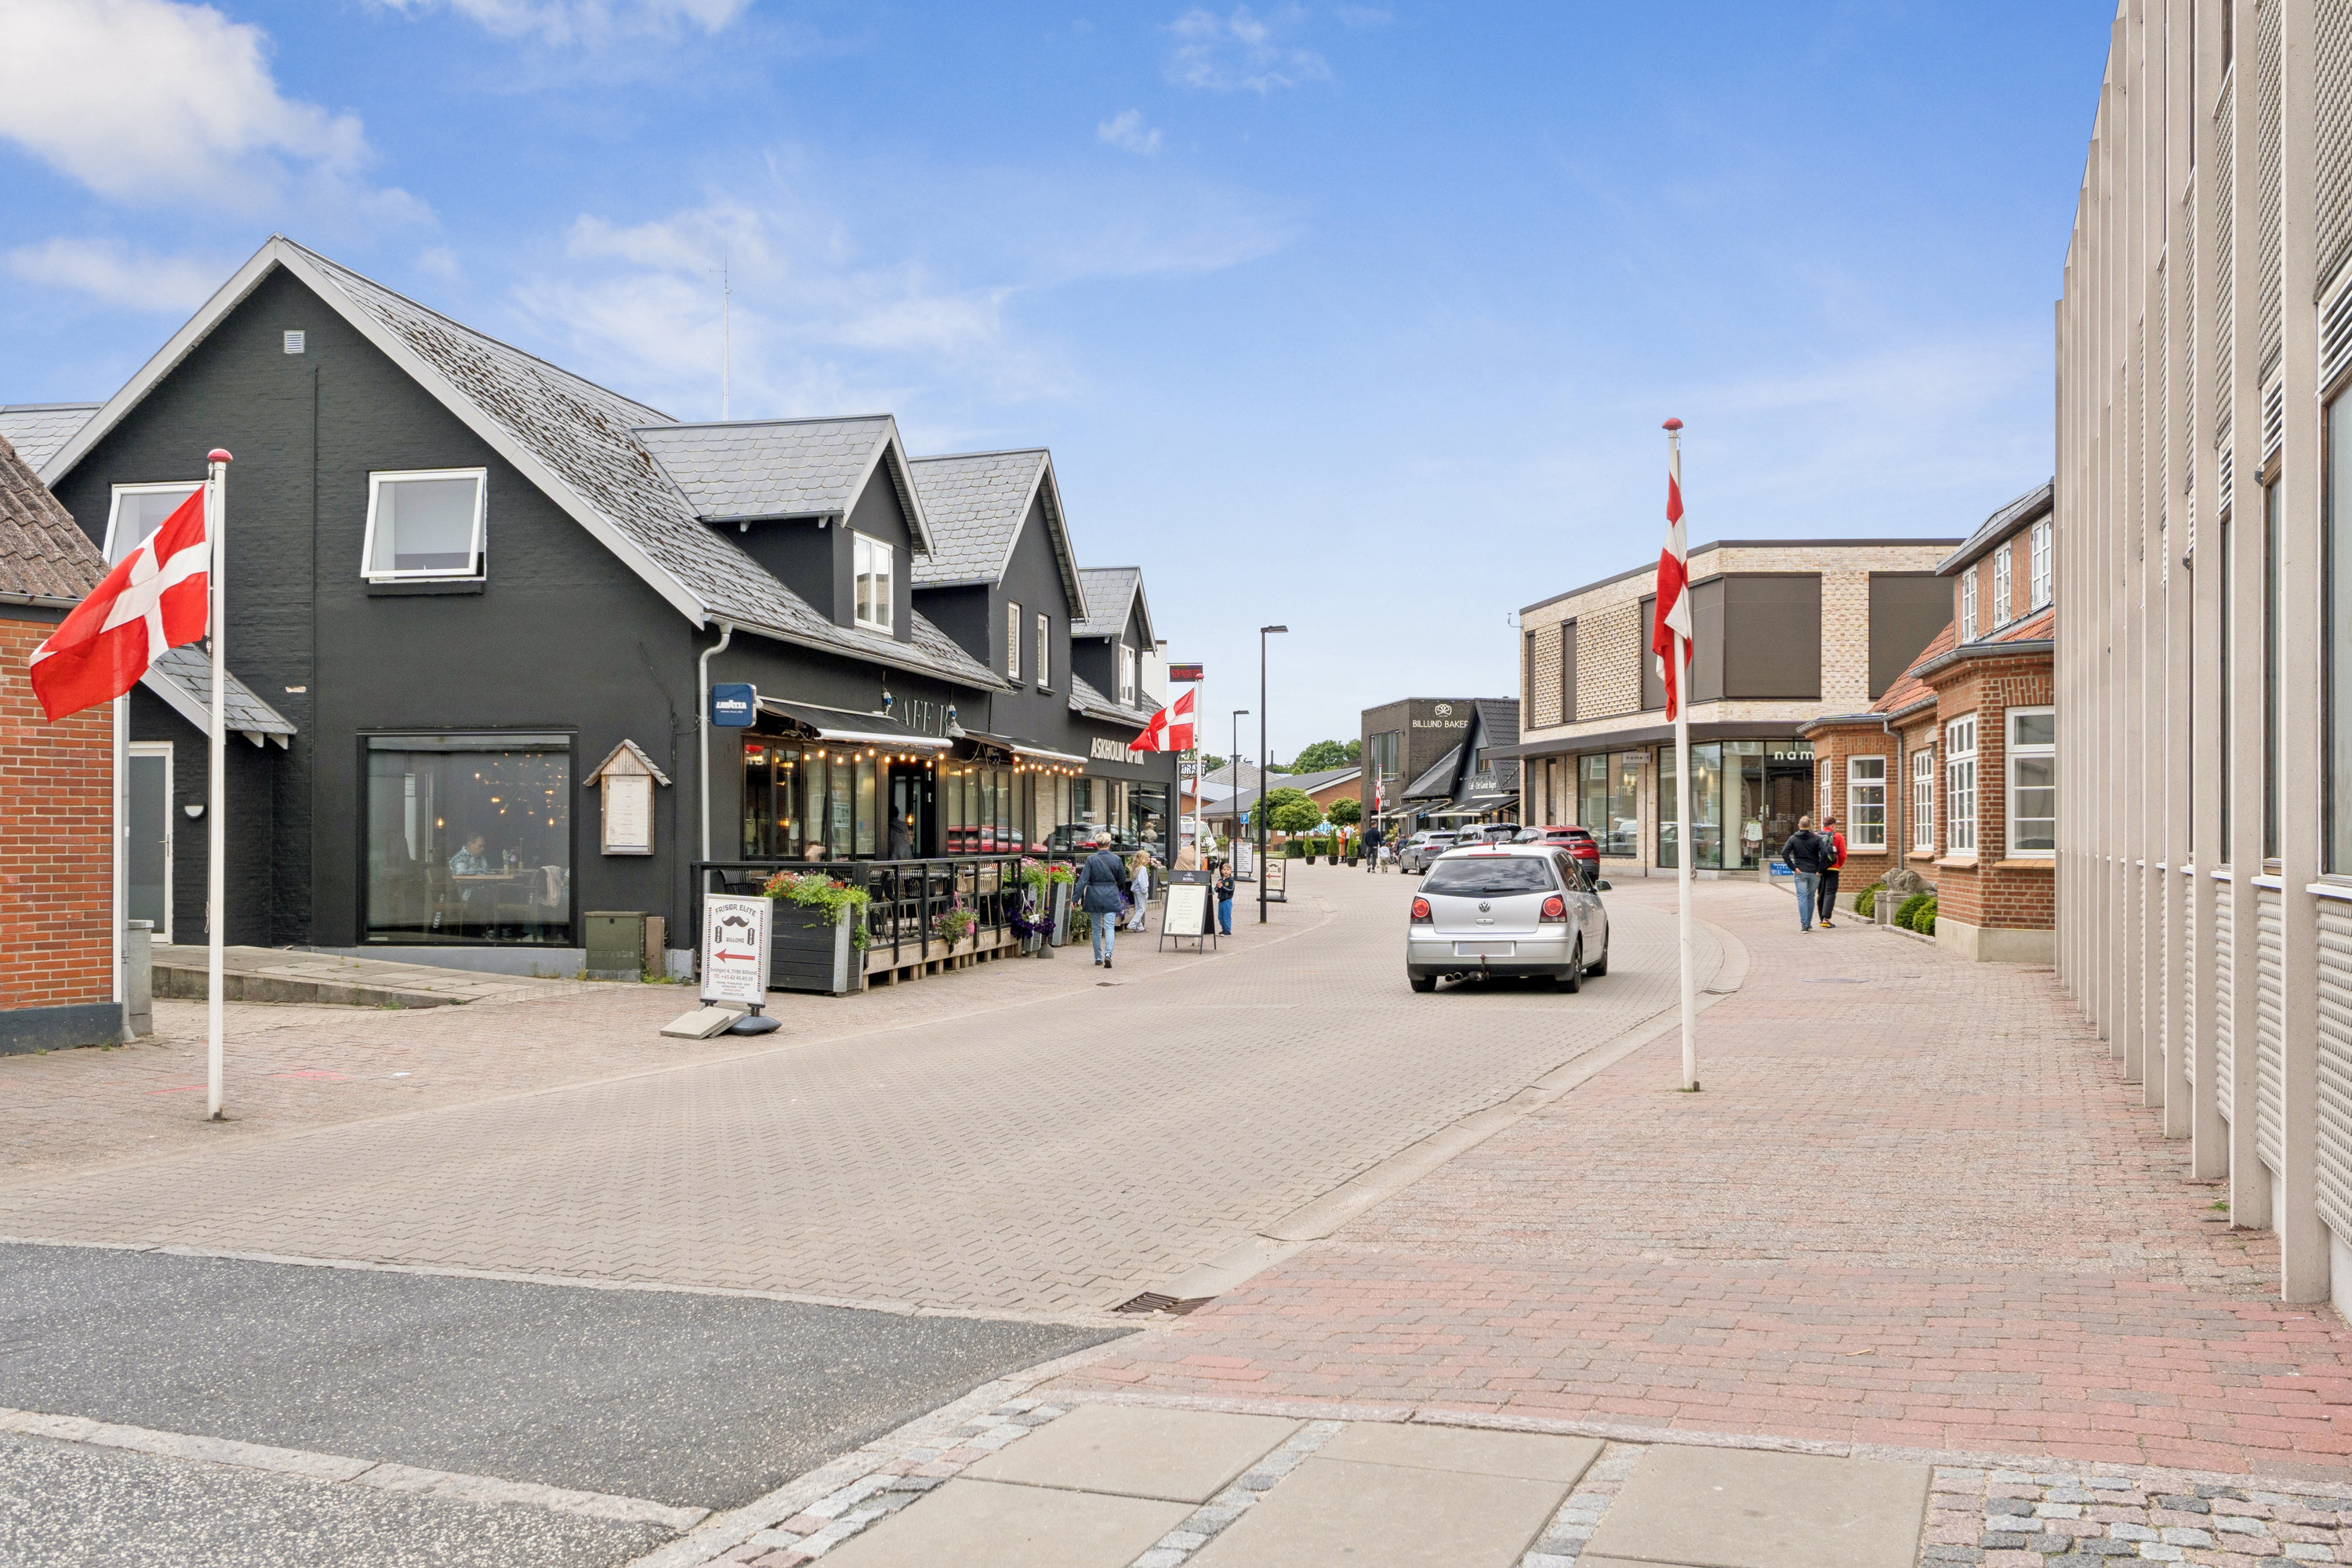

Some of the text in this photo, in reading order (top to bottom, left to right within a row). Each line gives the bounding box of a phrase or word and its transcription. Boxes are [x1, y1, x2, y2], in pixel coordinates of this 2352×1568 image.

[891, 695, 933, 735] AFE
[1412, 720, 1443, 728] BILLUND
[1090, 737, 1125, 762] ASKHOLM
[739, 905, 757, 916] ELITE
